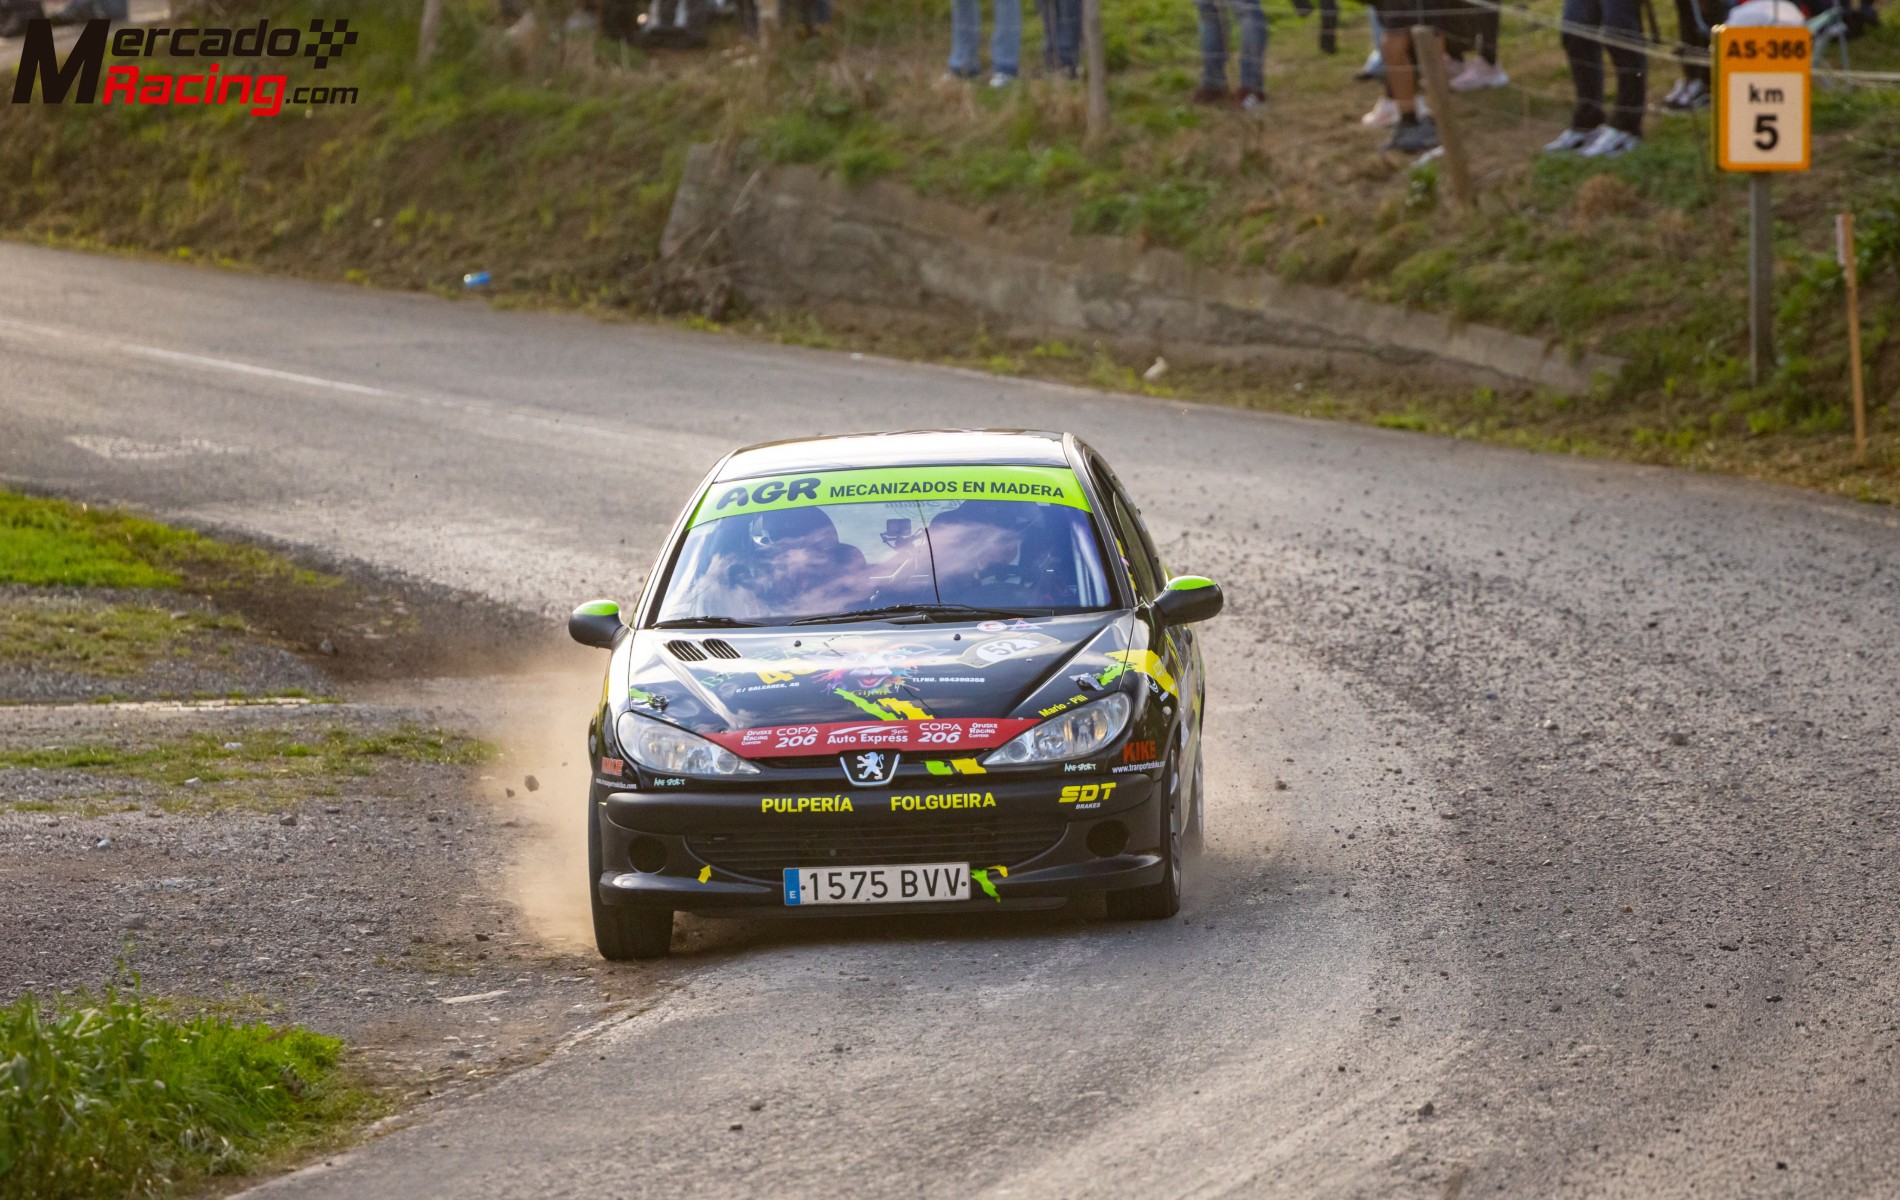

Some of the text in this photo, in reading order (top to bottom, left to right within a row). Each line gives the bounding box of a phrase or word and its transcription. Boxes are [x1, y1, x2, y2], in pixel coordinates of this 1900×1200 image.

[1726, 40, 1807, 59] AS-366
[1748, 83, 1784, 104] km
[1754, 113, 1779, 151] 5
[715, 477, 1065, 511] AGR MECANIZADOS EN MADERA
[1038, 702, 1067, 717] Mario
[776, 726, 819, 736] COPA
[919, 722, 962, 731] COPA
[775, 734, 817, 748] 206
[827, 733, 908, 745] Auto Express
[918, 731, 961, 743] 206
[1123, 741, 1156, 763] KIKE
[1058, 782, 1117, 803] SDT
[761, 792, 996, 813] PULPERÍA FOLGUEIRA
[1075, 802, 1101, 810] BRAKES
[789, 867, 962, 900] E 1575 BVV
